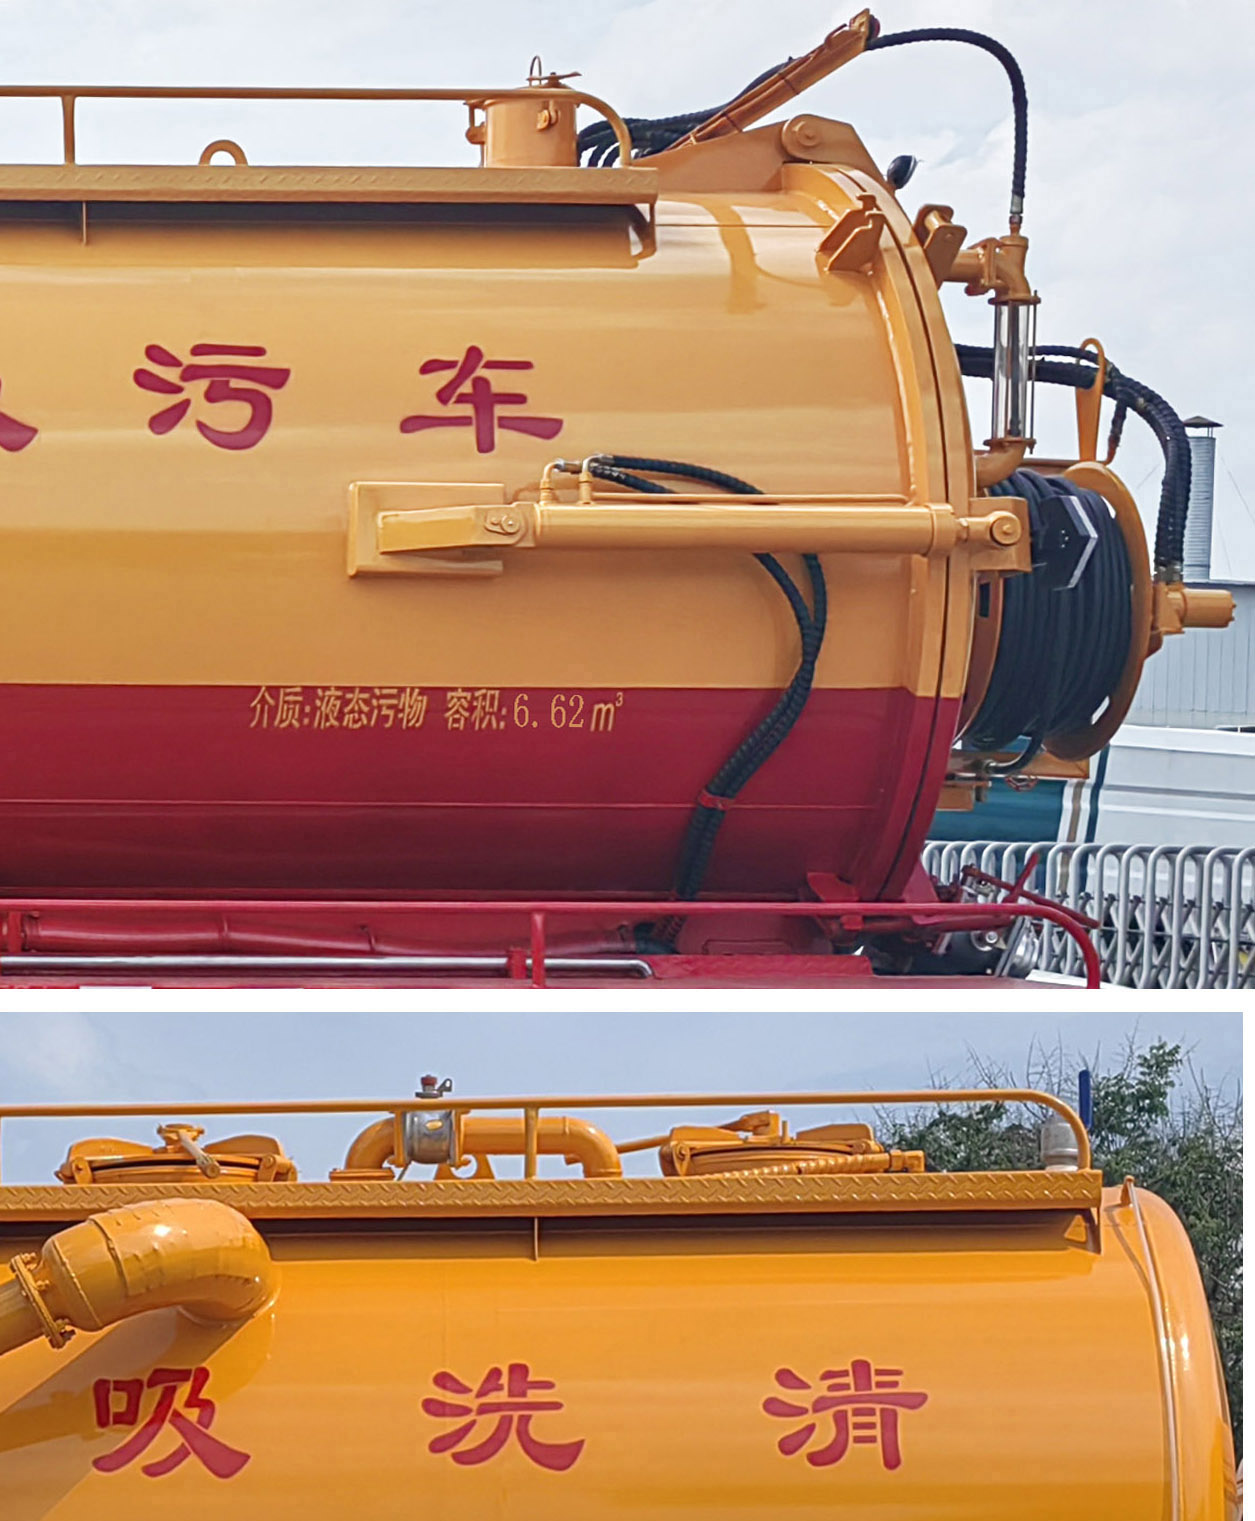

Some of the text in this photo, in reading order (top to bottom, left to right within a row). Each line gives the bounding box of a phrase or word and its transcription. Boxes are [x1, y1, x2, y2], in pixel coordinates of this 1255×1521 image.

[249, 686, 428, 730] 介质:液态污物
